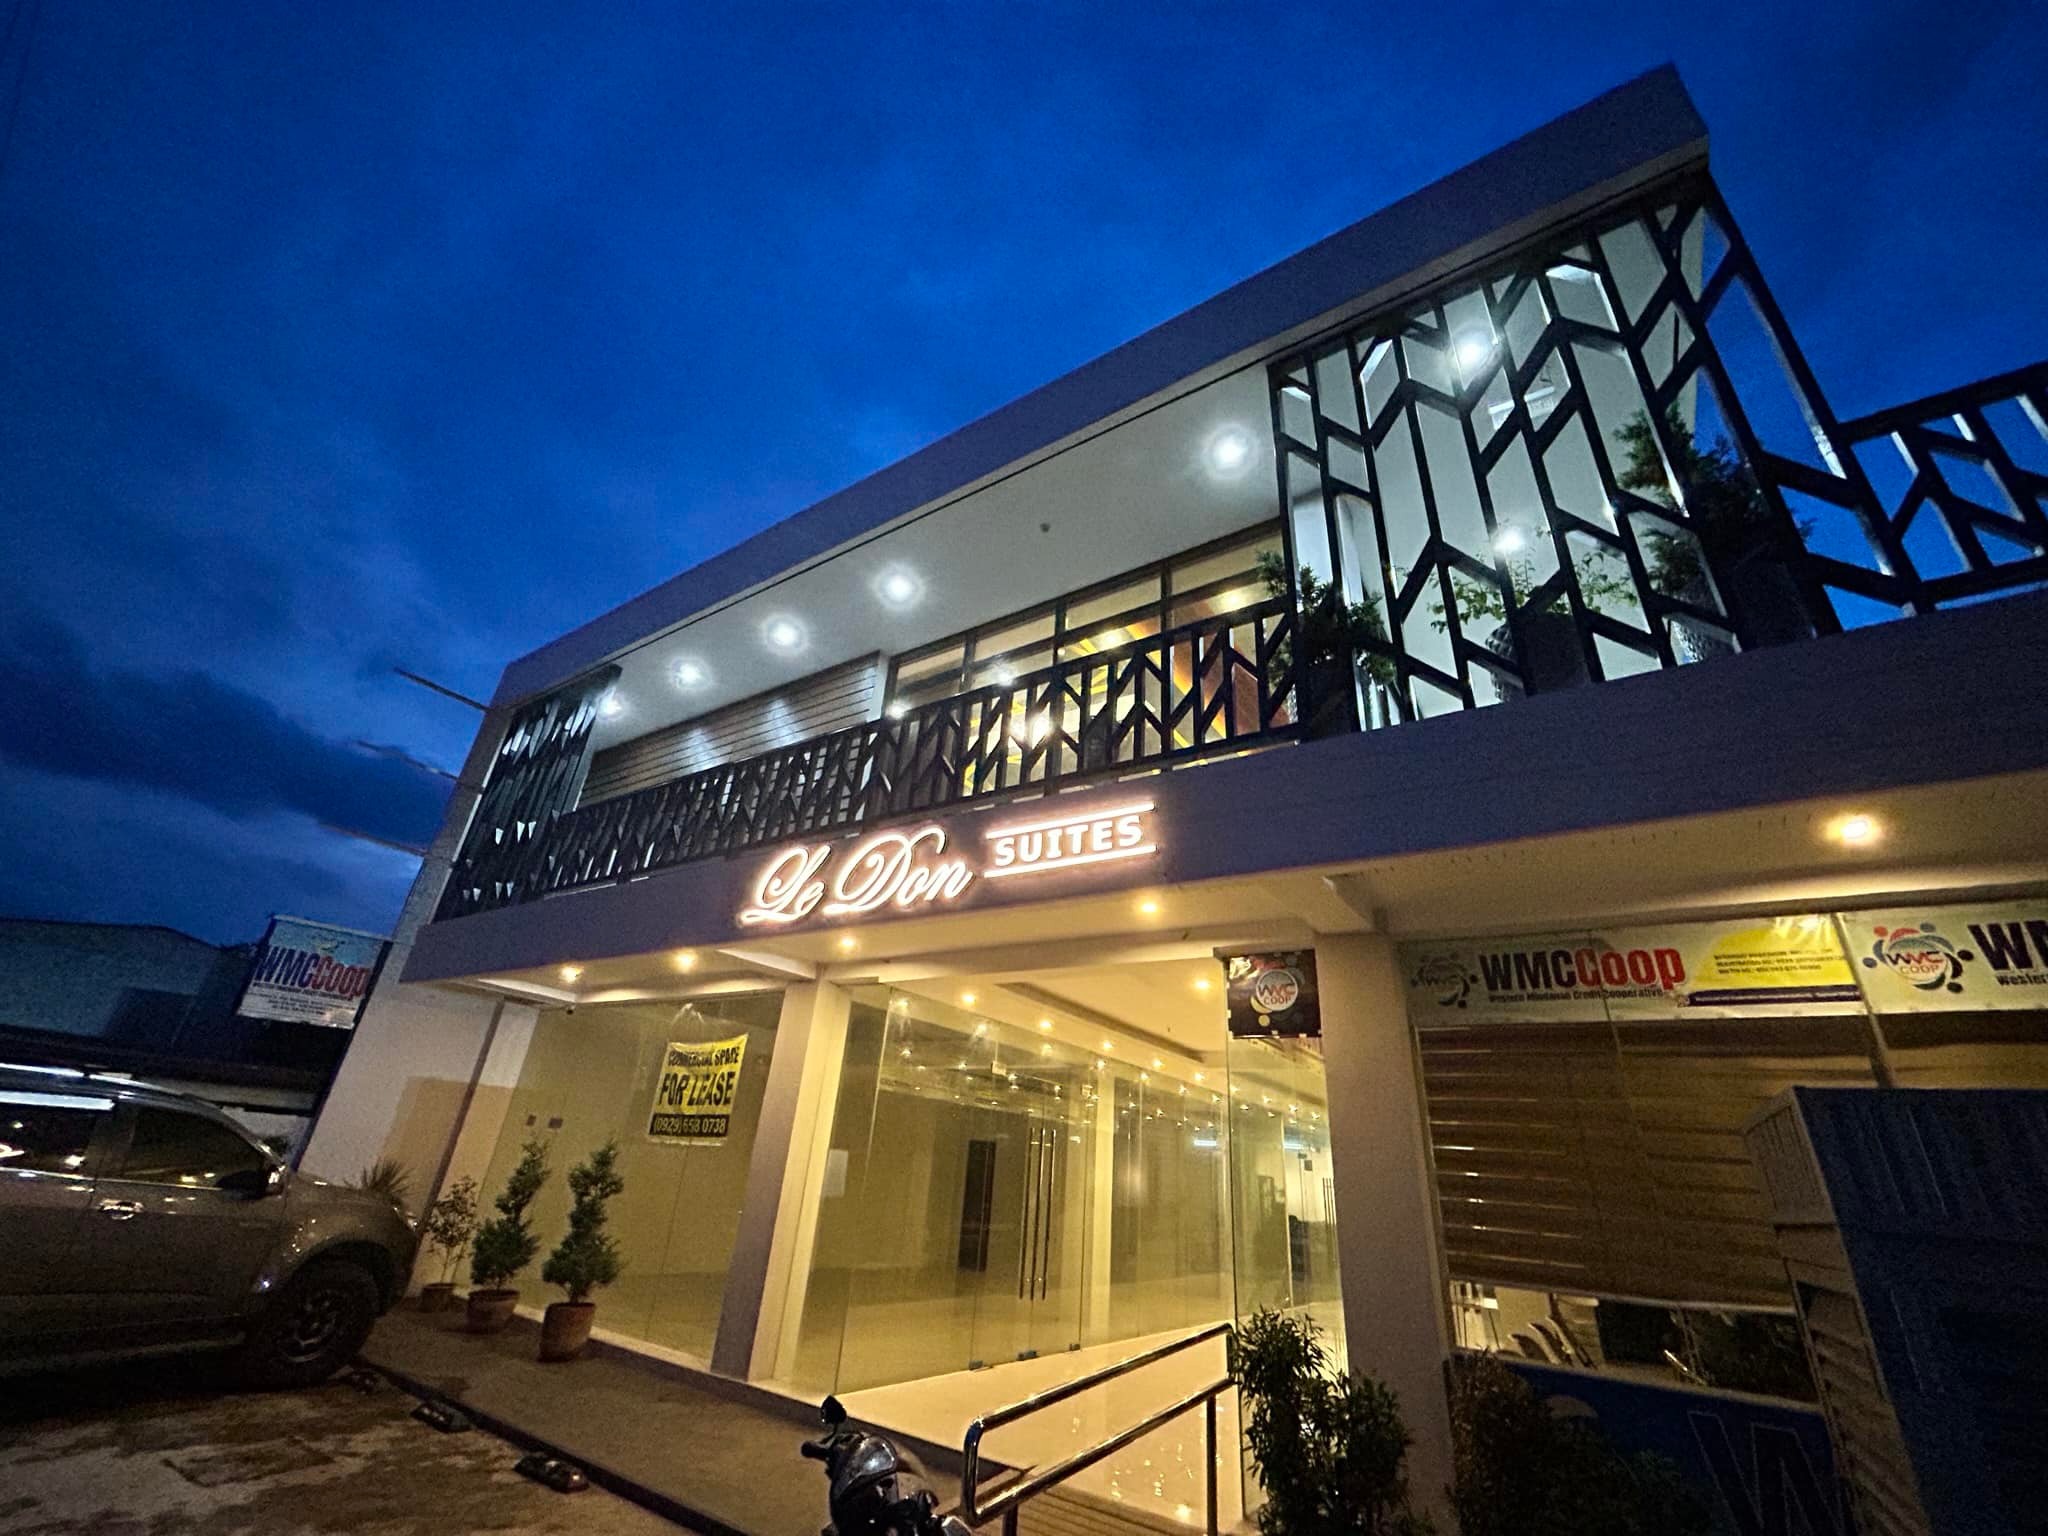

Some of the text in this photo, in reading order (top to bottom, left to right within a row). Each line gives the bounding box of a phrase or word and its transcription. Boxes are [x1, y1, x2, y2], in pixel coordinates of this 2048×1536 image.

[740, 815, 1144, 925] Le Don SUITES
[254, 946, 371, 1000] WMCCoop
[1479, 948, 1687, 990] WMCCoop
[1899, 963, 1940, 975] COOP
[714, 1046, 740, 1066] SPACE
[658, 1071, 735, 1106] FOR LEASE
[702, 1118, 727, 1134] 0738
